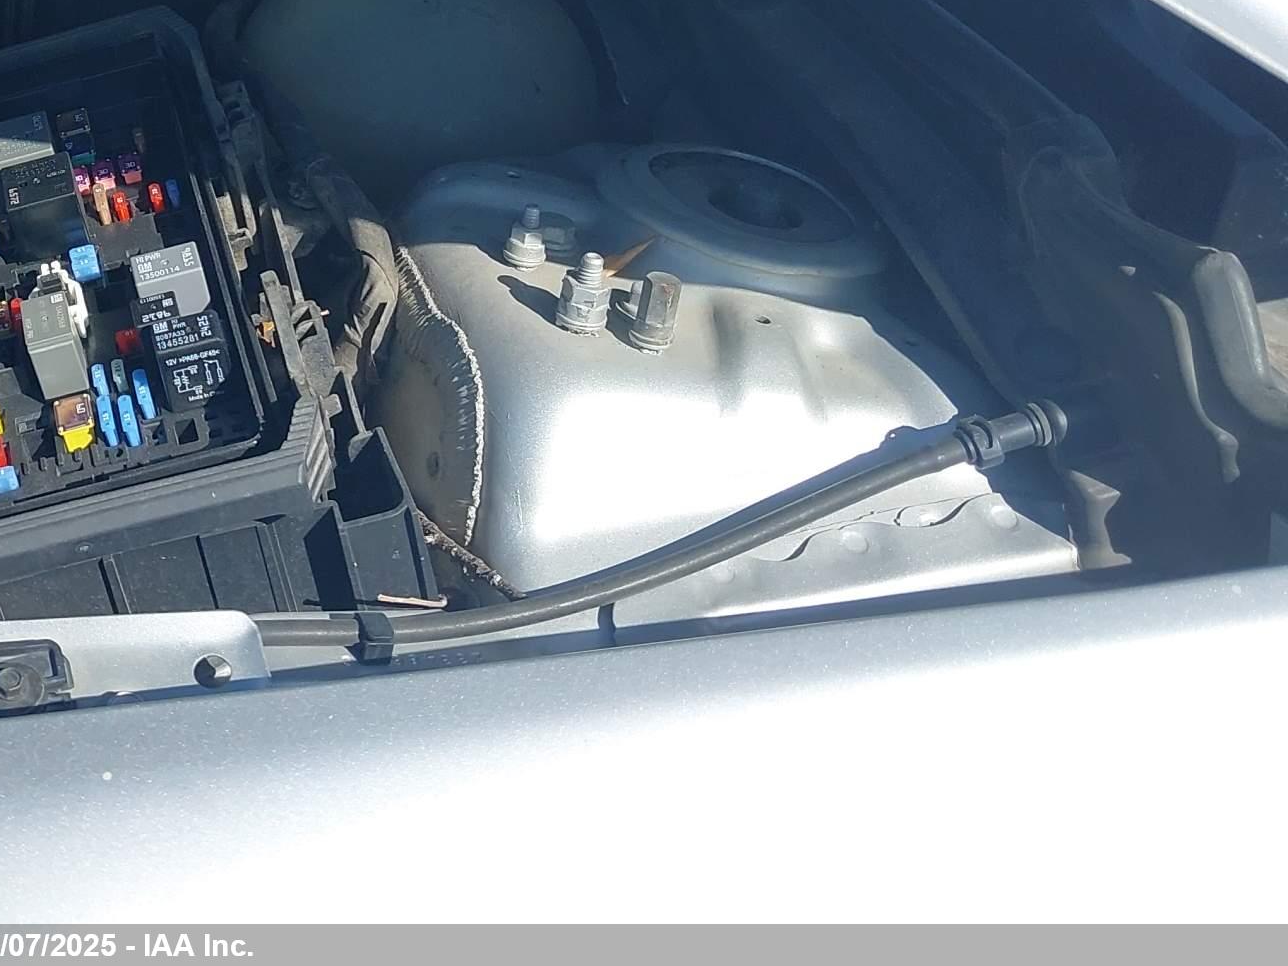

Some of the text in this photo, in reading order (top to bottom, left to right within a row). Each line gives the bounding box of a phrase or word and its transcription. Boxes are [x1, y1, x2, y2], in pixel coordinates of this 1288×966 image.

[145, 252, 161, 262] PWR
[139, 265, 181, 281] 13500114
[153, 321, 169, 334] GM
[197, 315, 212, 337] 2425
